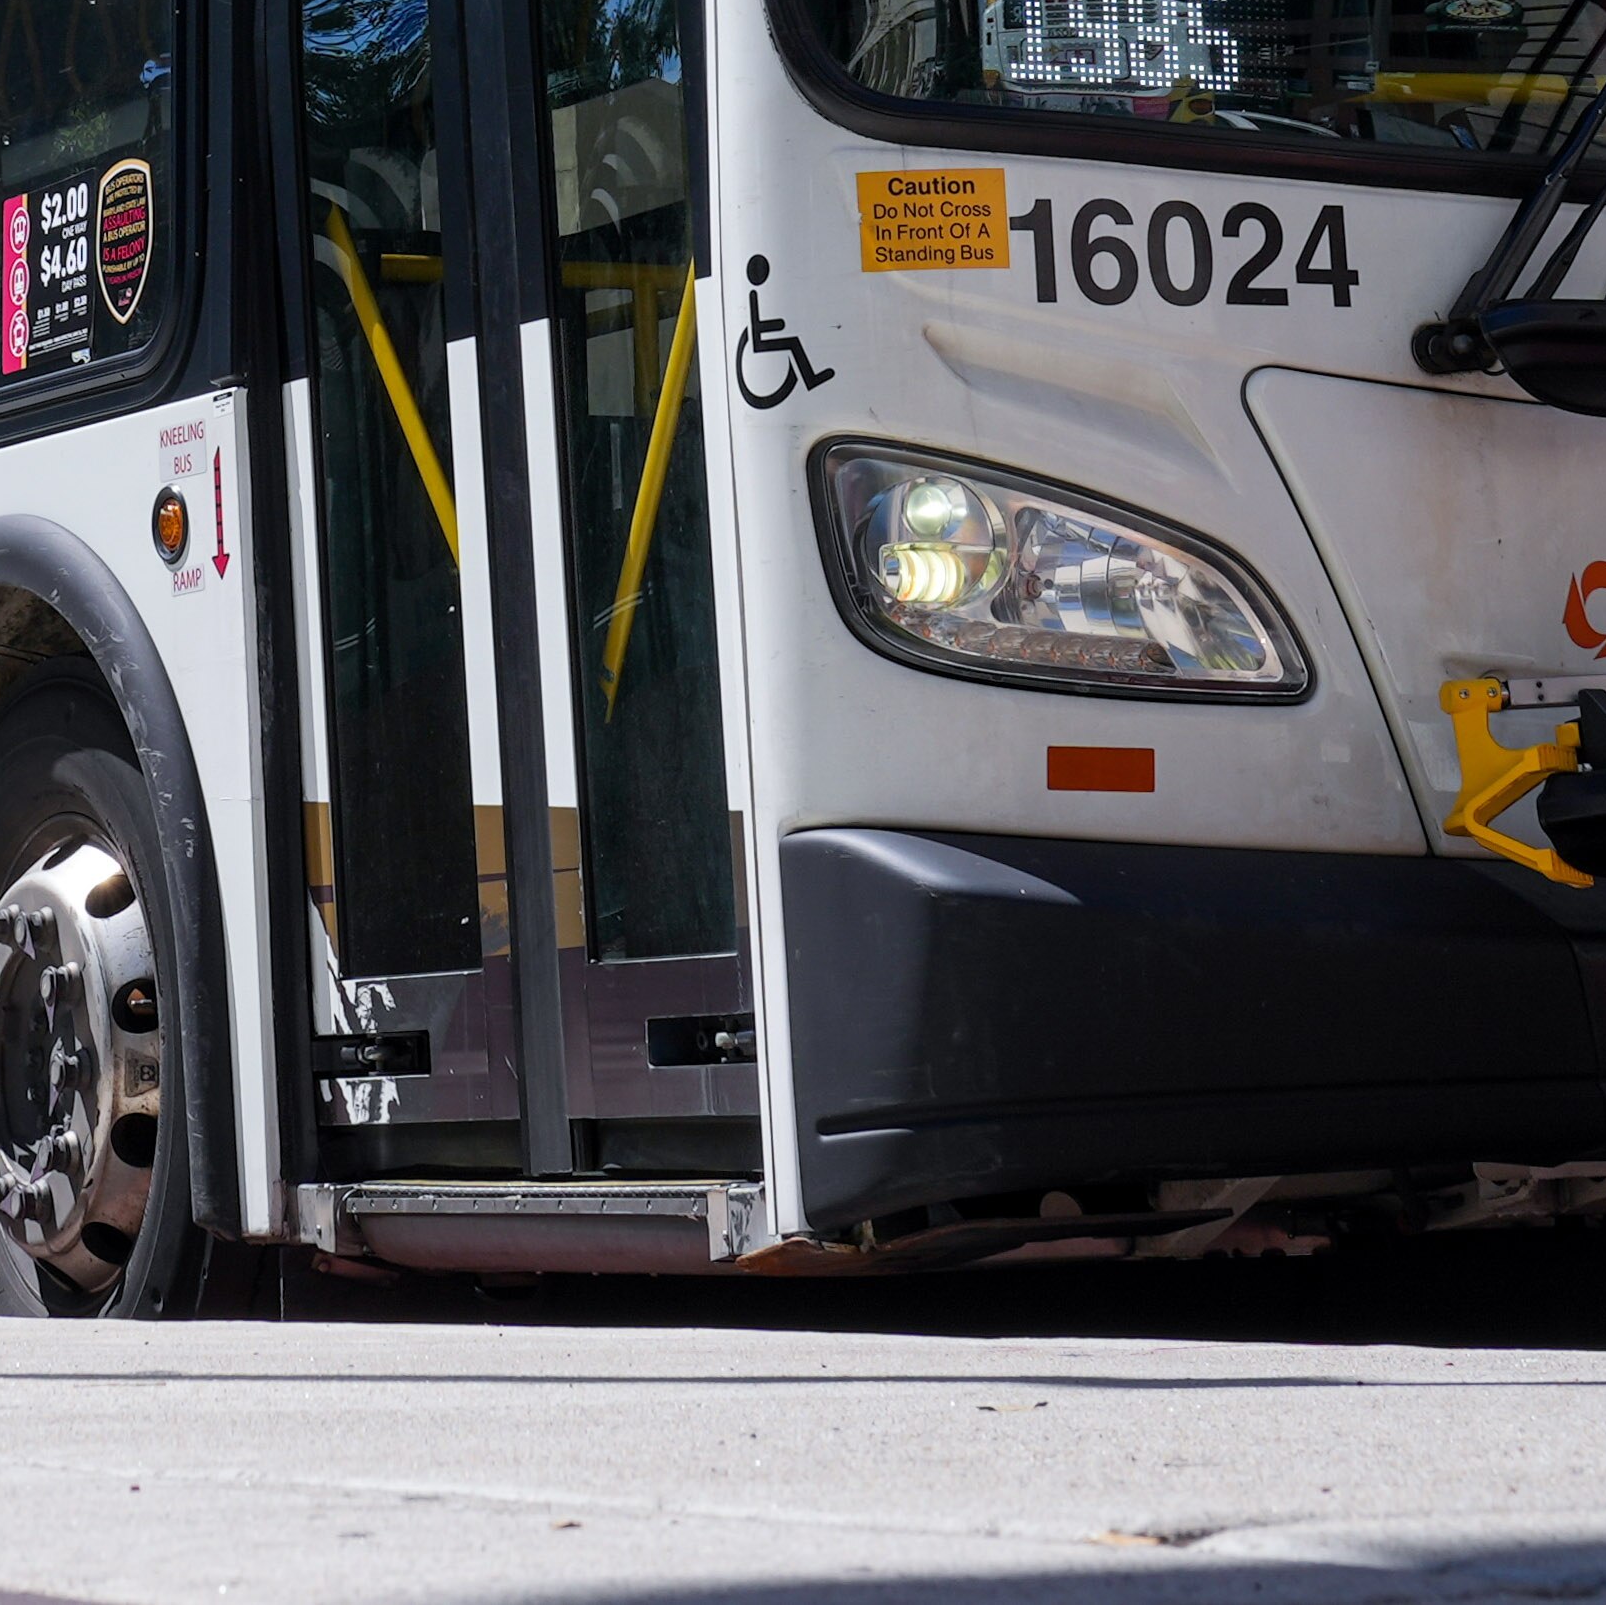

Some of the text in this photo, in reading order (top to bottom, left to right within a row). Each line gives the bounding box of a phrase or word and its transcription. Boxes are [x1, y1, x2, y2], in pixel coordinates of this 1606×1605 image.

[888, 176, 975, 196] Caution
[41, 182, 88, 235] $2.00
[103, 207, 145, 230] ASSAULTING
[873, 201, 992, 220] Do Not Cross
[876, 222, 991, 241] In Front Of A
[117, 236, 146, 260] FELONY
[875, 245, 994, 265] Standing Bus
[1009, 197, 1360, 308] 16024
[40, 235, 88, 288] $4.60
[160, 420, 204, 448] KNEELING
[174, 453, 192, 474] BUS
[173, 568, 202, 593] RAMP
